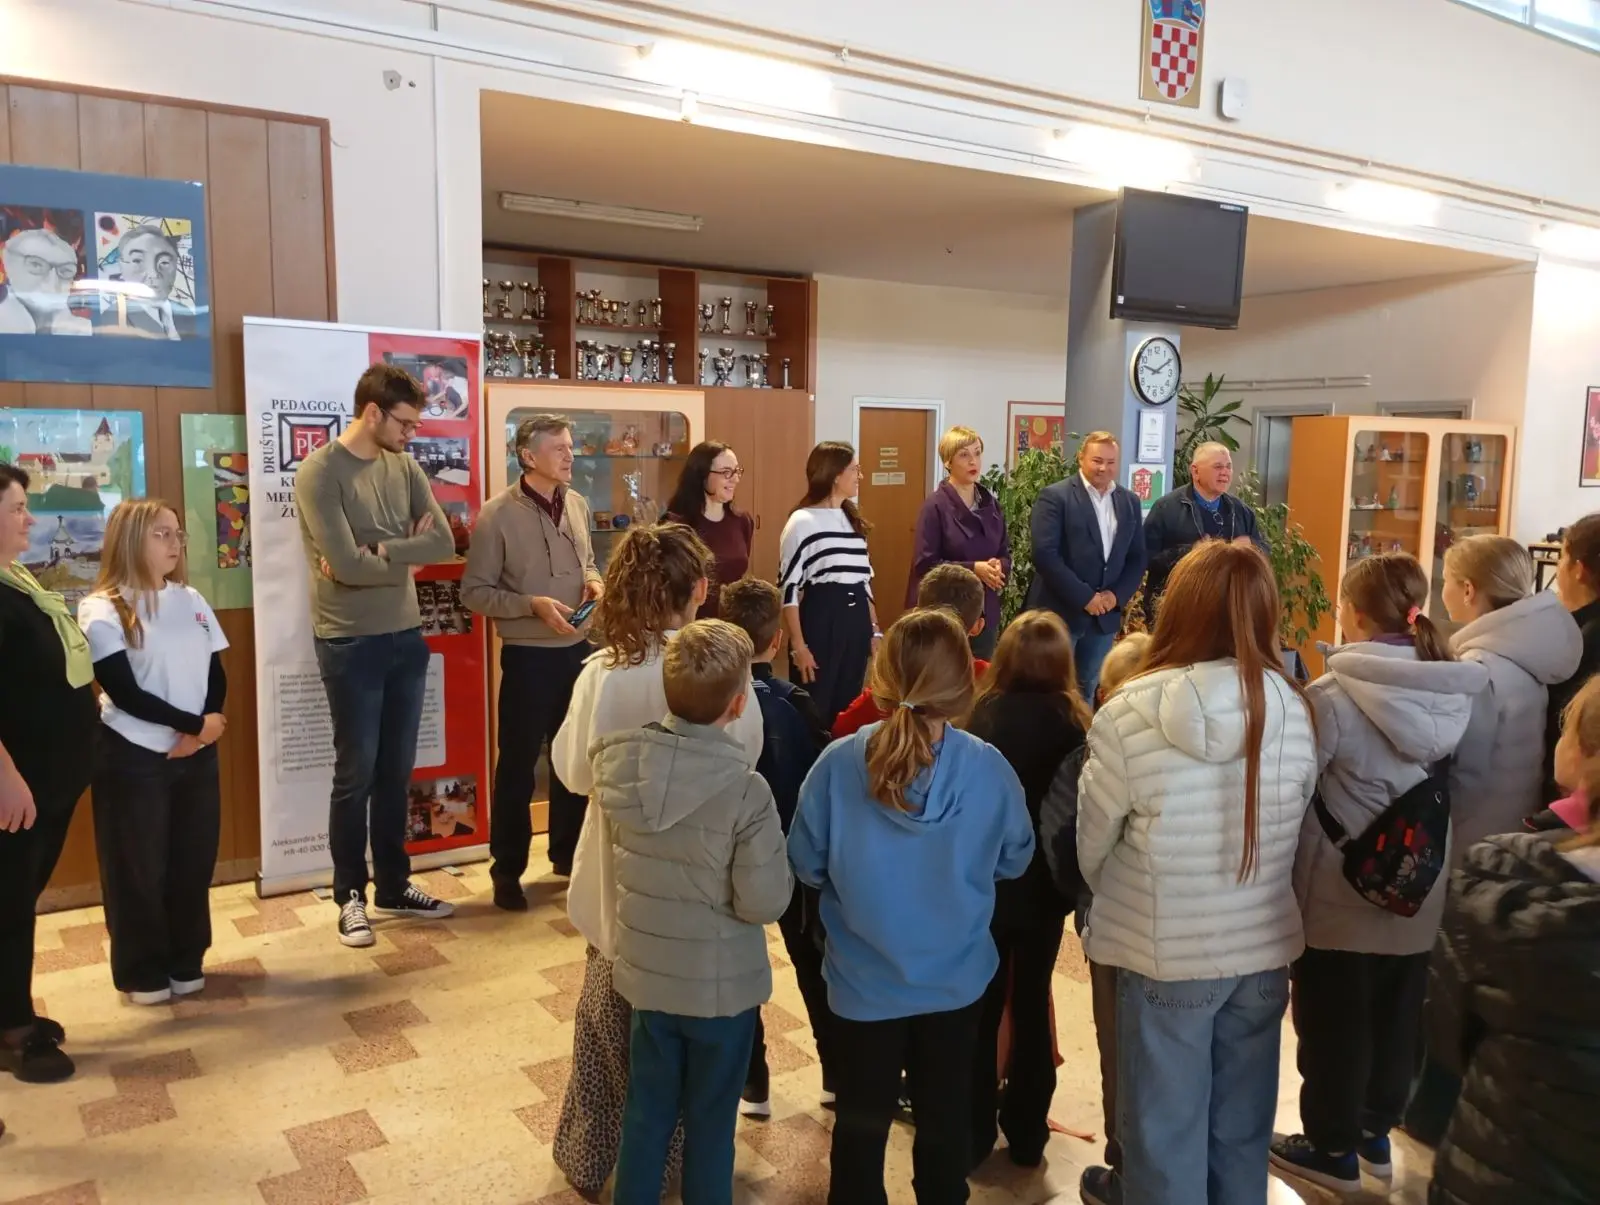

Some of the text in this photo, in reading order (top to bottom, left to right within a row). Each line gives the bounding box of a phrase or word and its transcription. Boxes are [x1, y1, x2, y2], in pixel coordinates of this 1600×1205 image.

[271, 399, 346, 412] PEDAGOGA
[259, 412, 275, 474] DRUŠTVO
[271, 835, 316, 847] Aleksandra
